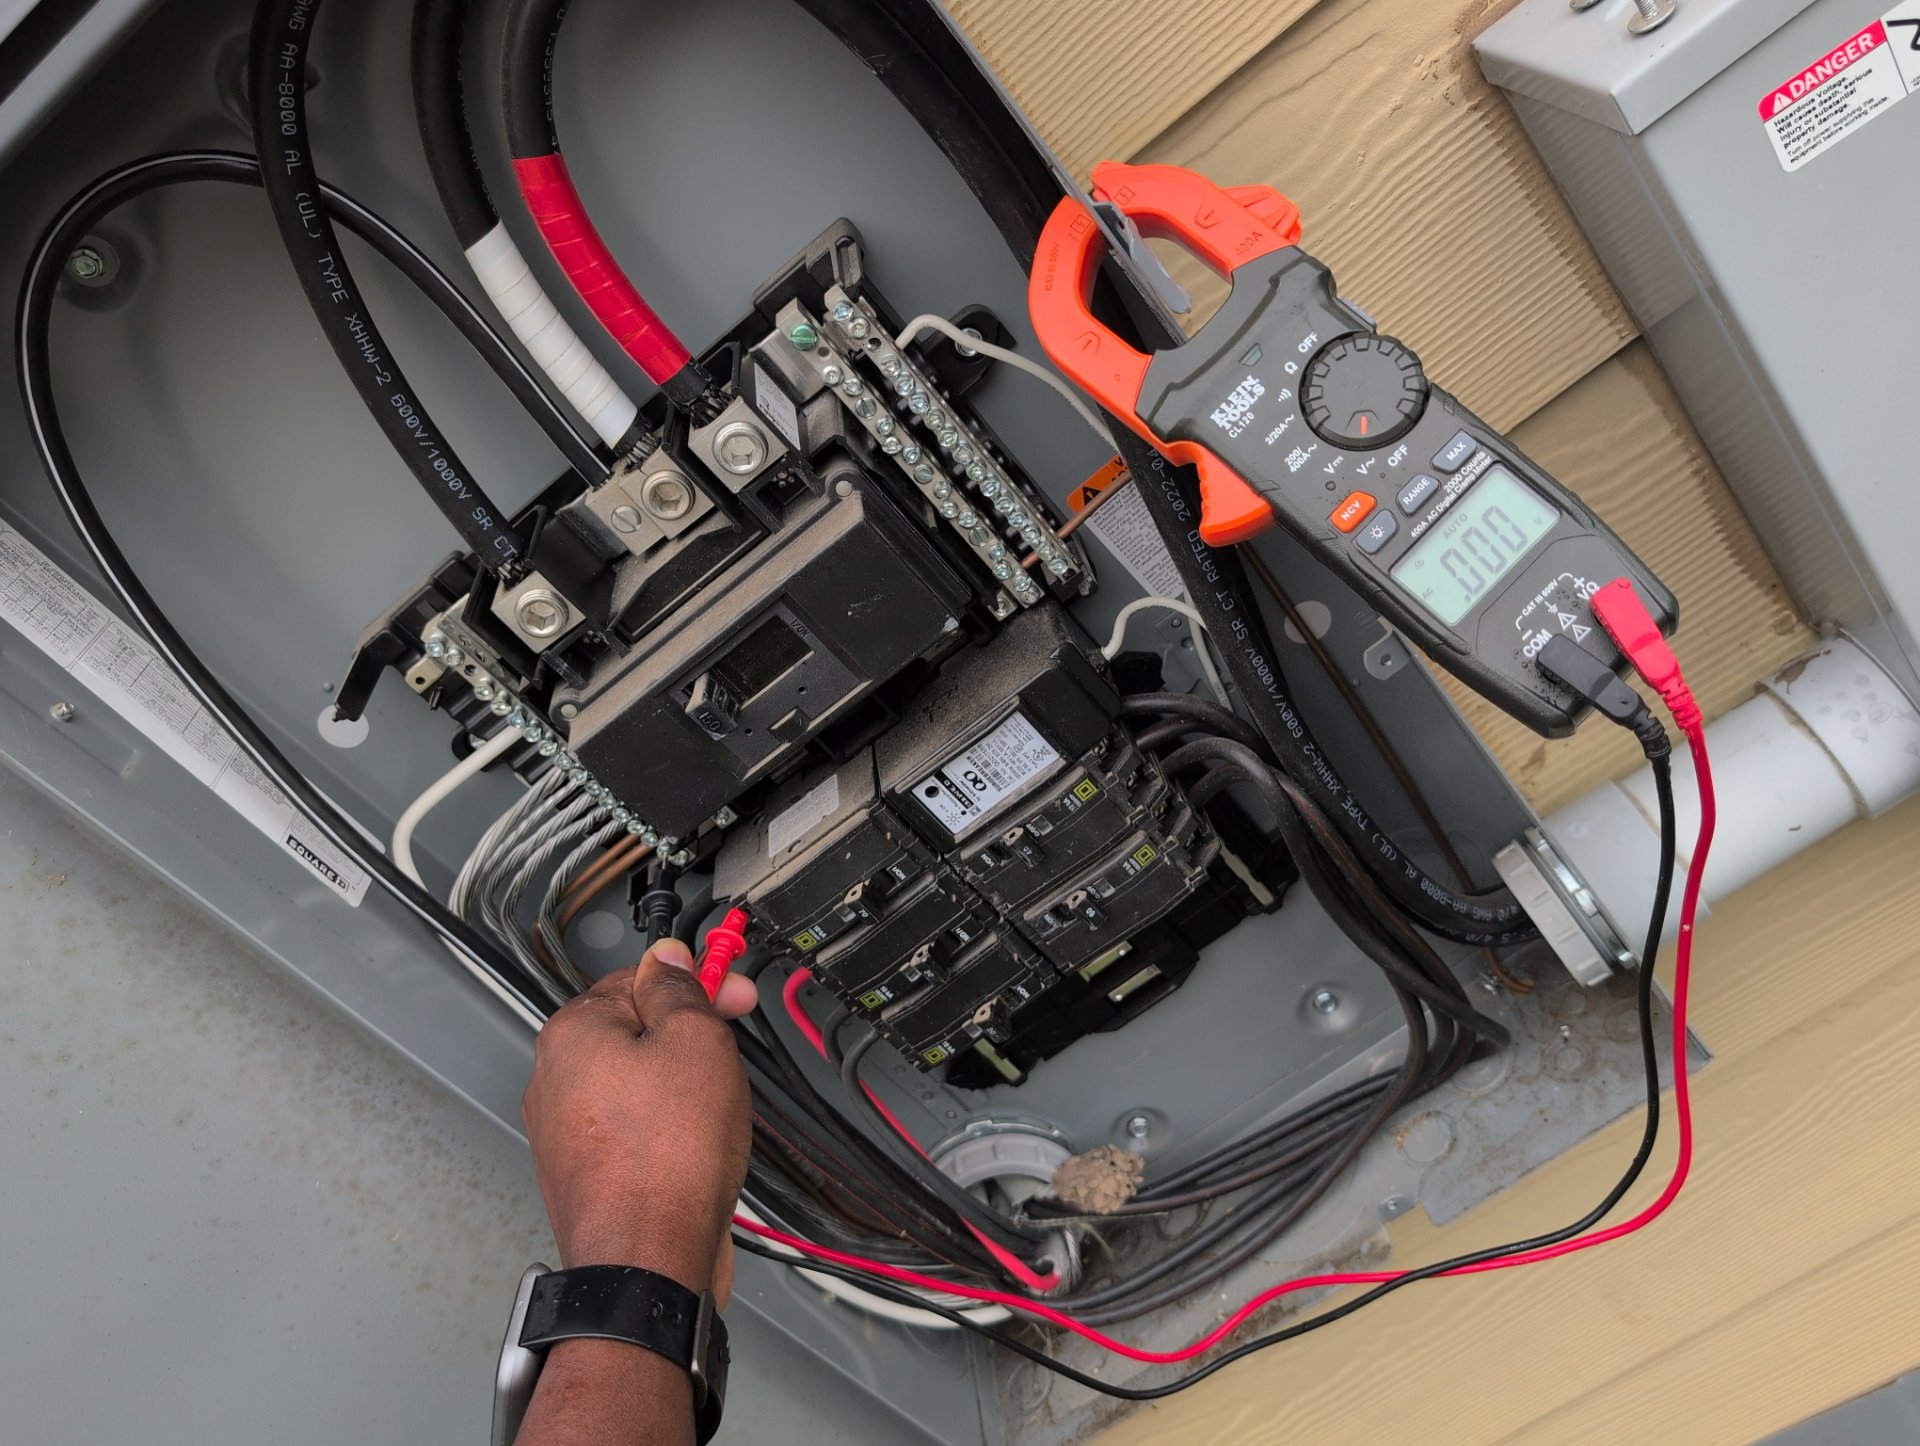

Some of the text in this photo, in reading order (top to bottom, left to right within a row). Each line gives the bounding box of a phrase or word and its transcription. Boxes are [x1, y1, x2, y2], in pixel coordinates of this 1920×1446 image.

[1788, 32, 1874, 98] DANGER
[1774, 75, 1849, 127] Hazardous Voltage.
[1776, 69, 1872, 134] Will cause death, serious
[1780, 88, 1857, 141] injury or substantial
[1783, 103, 1850, 149] property damage.
[284, 150, 302, 175] AL
[318, 251, 349, 303] TYPE
[344, 312, 392, 387] XHHW-2
[390, 393, 473, 500] 600V/1000V
[471, 506, 495, 531] SR
[494, 535, 518, 558] CT
[1298, 332, 1319, 354] OFF
[1219, 383, 1266, 430] TOOLS
[1228, 411, 1255, 439] CL120
[1387, 445, 1409, 468] OFF
[1446, 441, 1467, 462] MAX
[1444, 451, 1486, 493] 2000 Counts
[1403, 478, 1430, 506] RANGE
[1411, 456, 1493, 538] 400A AC Digital Clamp Meter
[1342, 501, 1361, 520] NCV
[1442, 513, 1469, 539] AUTO
[1187, 529, 1220, 584] RATED
[1215, 591, 1235, 611] CT
[1522, 580, 1558, 616] CAT III 600V
[1230, 616, 1249, 641] SR
[1522, 629, 1552, 658] COM
[699, 712, 721, 730] 150
[963, 768, 987, 793] QO
[1303, 741, 1341, 797] XHHW-2
[1340, 797, 1369, 832] TYPE
[1023, 845, 1033, 855] 40
[858, 909, 869, 918] 70
